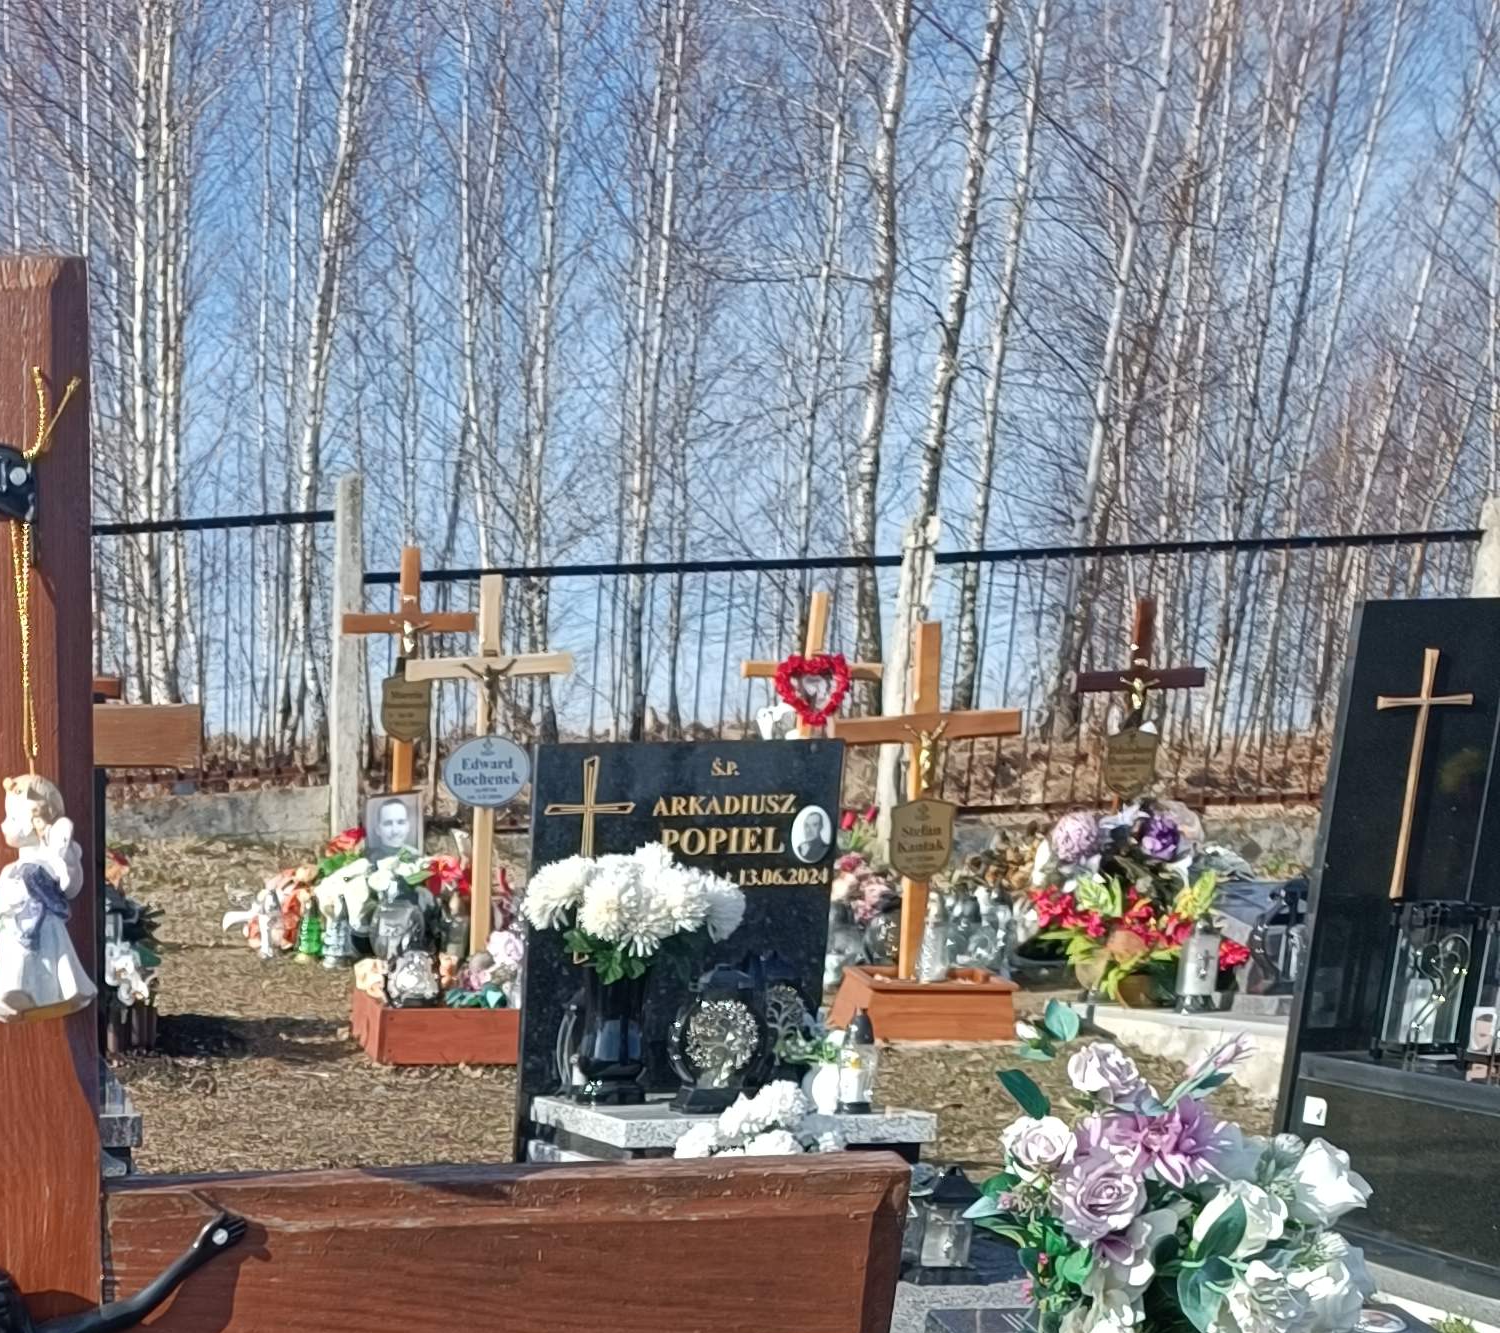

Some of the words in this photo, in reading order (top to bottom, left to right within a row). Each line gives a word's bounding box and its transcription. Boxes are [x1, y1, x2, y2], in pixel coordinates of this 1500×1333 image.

[462, 757, 513, 770] Edward
[453, 771, 520, 786] Bochenek
[652, 793, 797, 817] ARKADIUSZ
[662, 826, 785, 855] POPIEL
[739, 867, 829, 887] 13.06.2024
